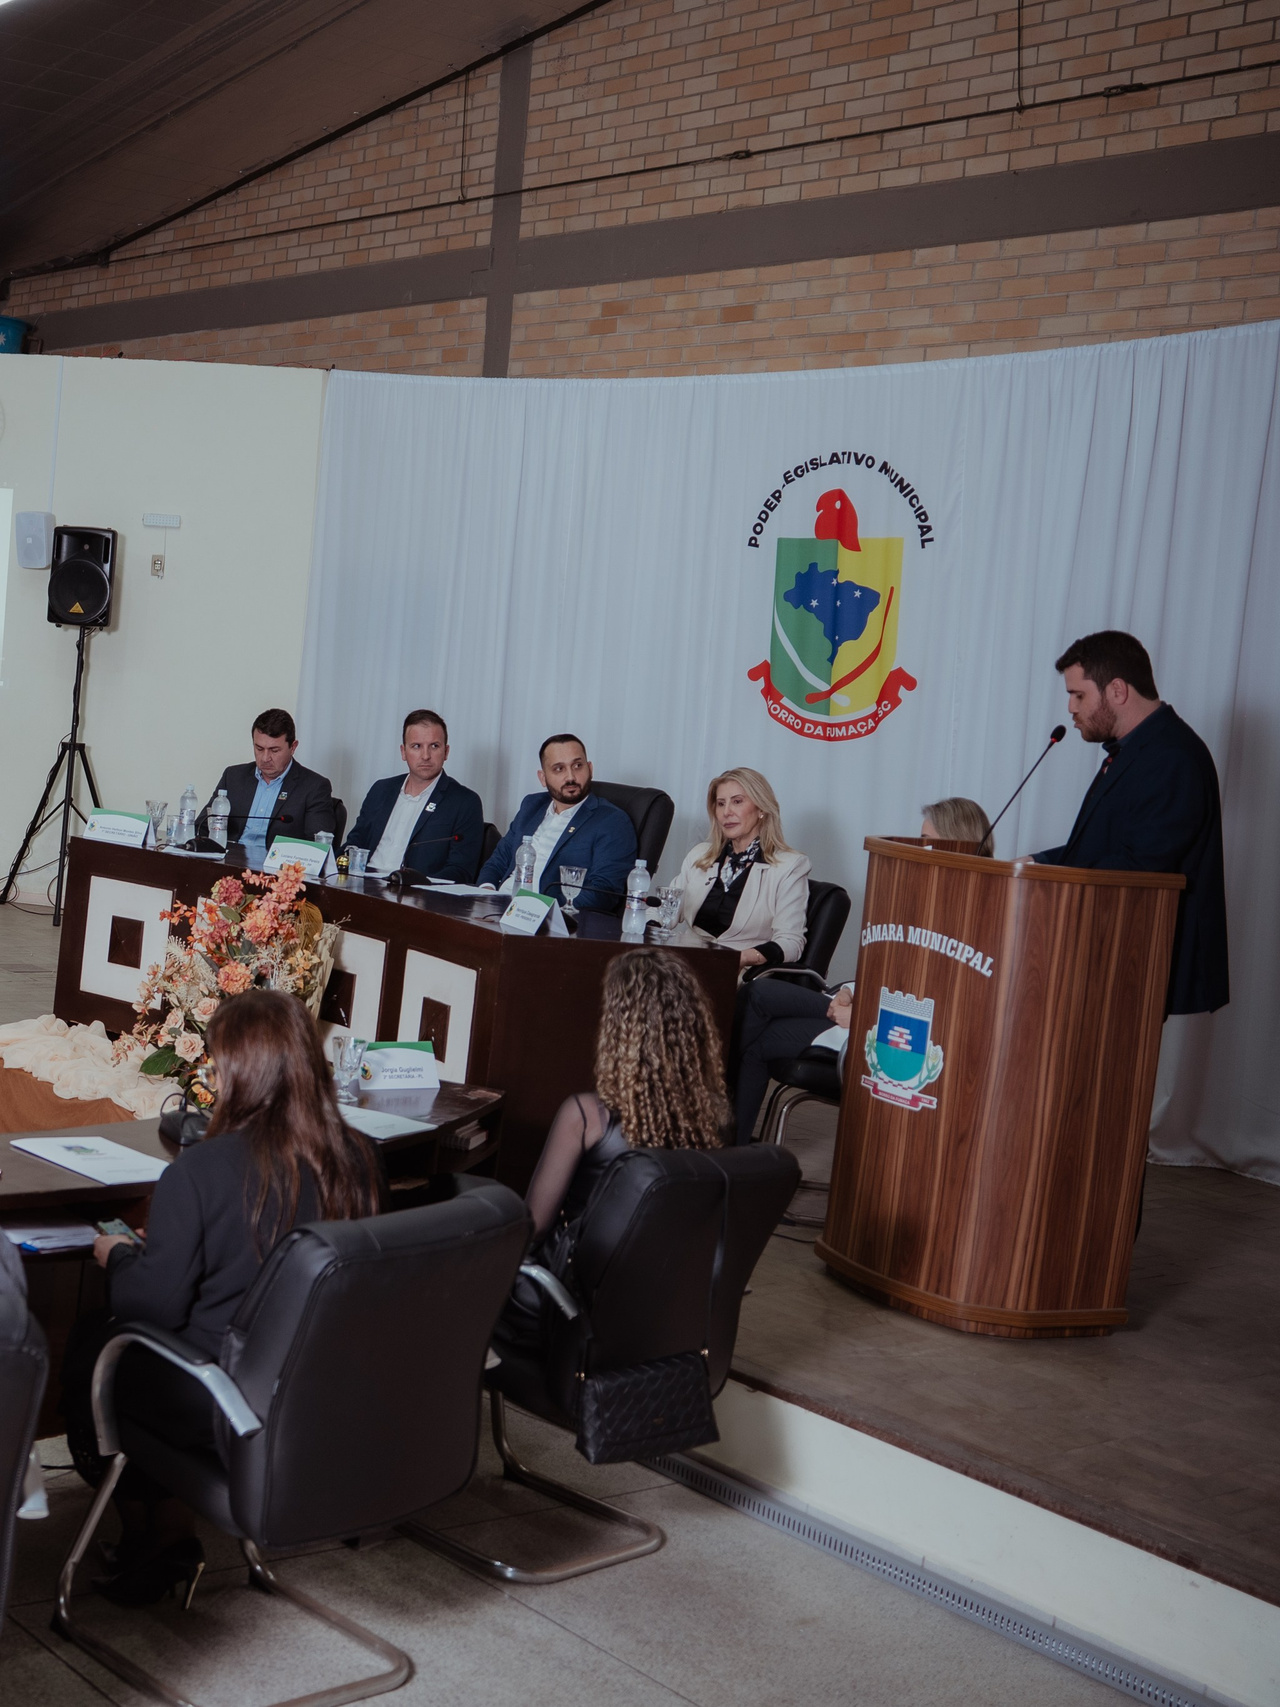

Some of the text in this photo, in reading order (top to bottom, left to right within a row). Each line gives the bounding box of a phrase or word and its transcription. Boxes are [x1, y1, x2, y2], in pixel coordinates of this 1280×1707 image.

[878, 461, 934, 549] MUNICIPAL
[803, 723, 824, 736] DA
[826, 718, 876, 737] FUMAÇA
[861, 922, 994, 978] CÂMARA MUNICIPAL
